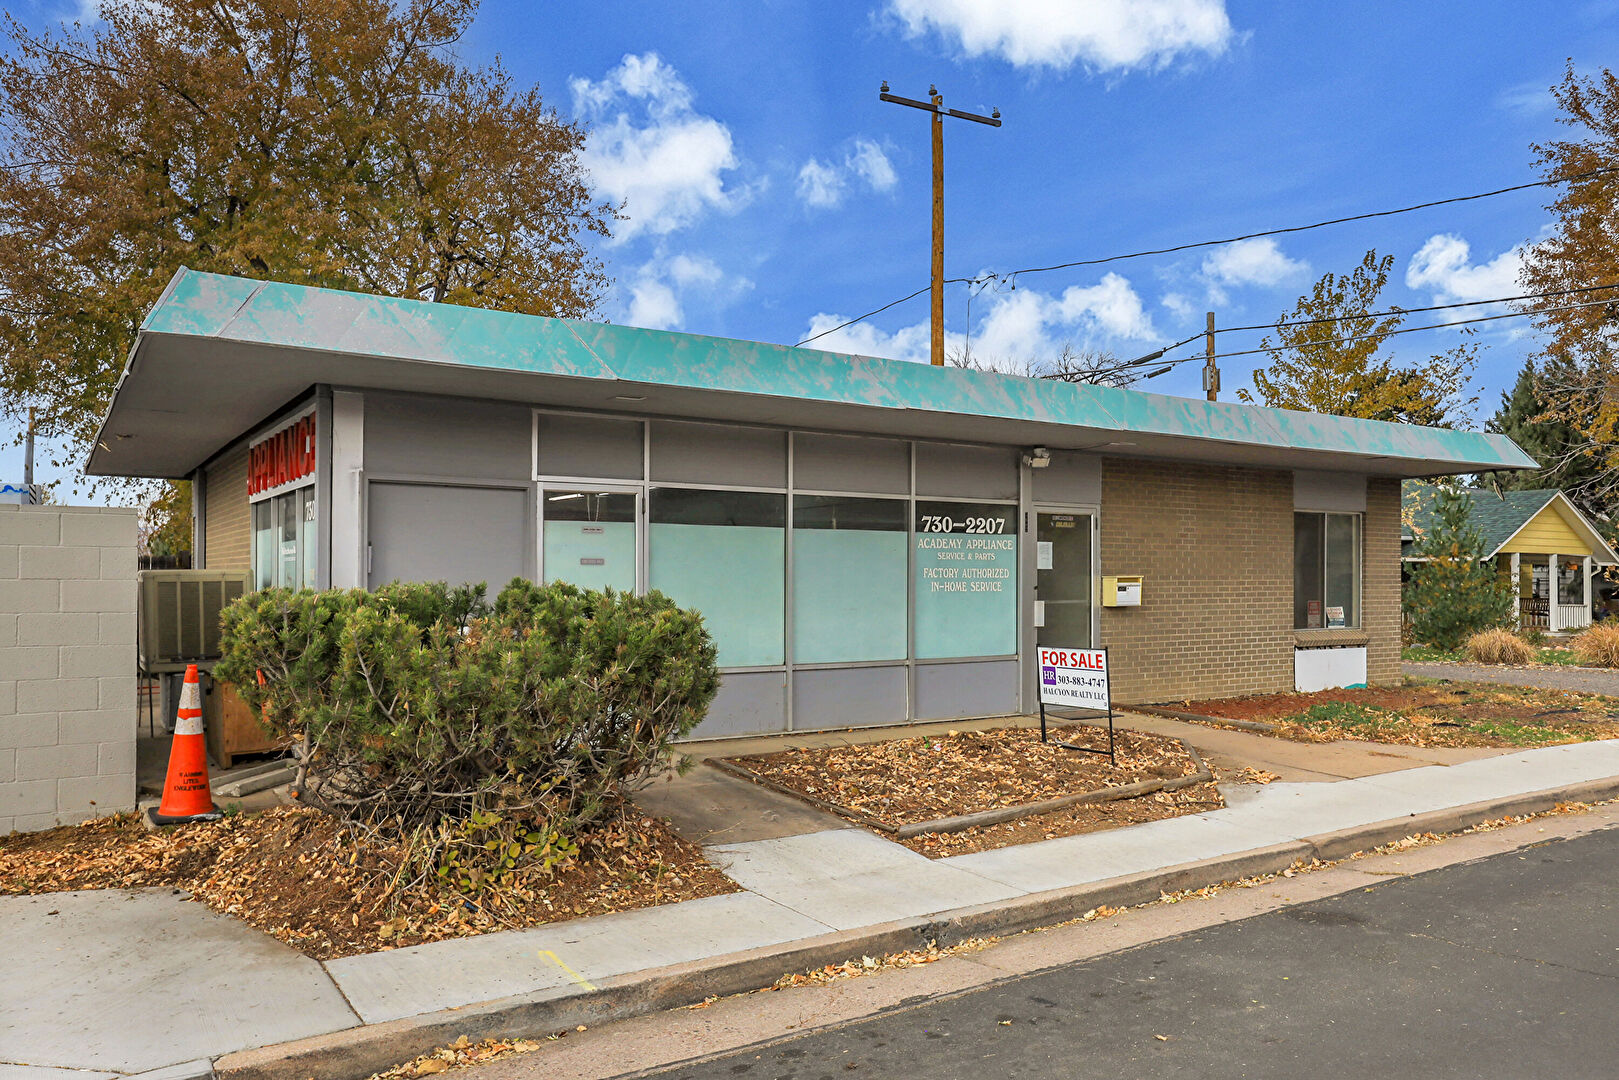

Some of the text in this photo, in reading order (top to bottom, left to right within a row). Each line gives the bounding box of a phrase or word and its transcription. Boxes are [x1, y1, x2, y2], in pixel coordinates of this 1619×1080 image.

[248, 411, 316, 496] APPLIANCE
[921, 515, 1006, 534] 730-2207
[918, 538, 1014, 550] ACADEMY APPLIANCE
[937, 552, 996, 561] SERVICE & PARTS
[923, 567, 1010, 579] FACTORY AUTHORIZED
[931, 581, 1002, 592] IN-HOME SERVICE
[1042, 650, 1103, 669] FOR SALE
[1043, 670, 1056, 680] HR
[1057, 675, 1105, 688] 303-883-4747
[1043, 687, 1106, 701] HALCYON REALTY LLC
